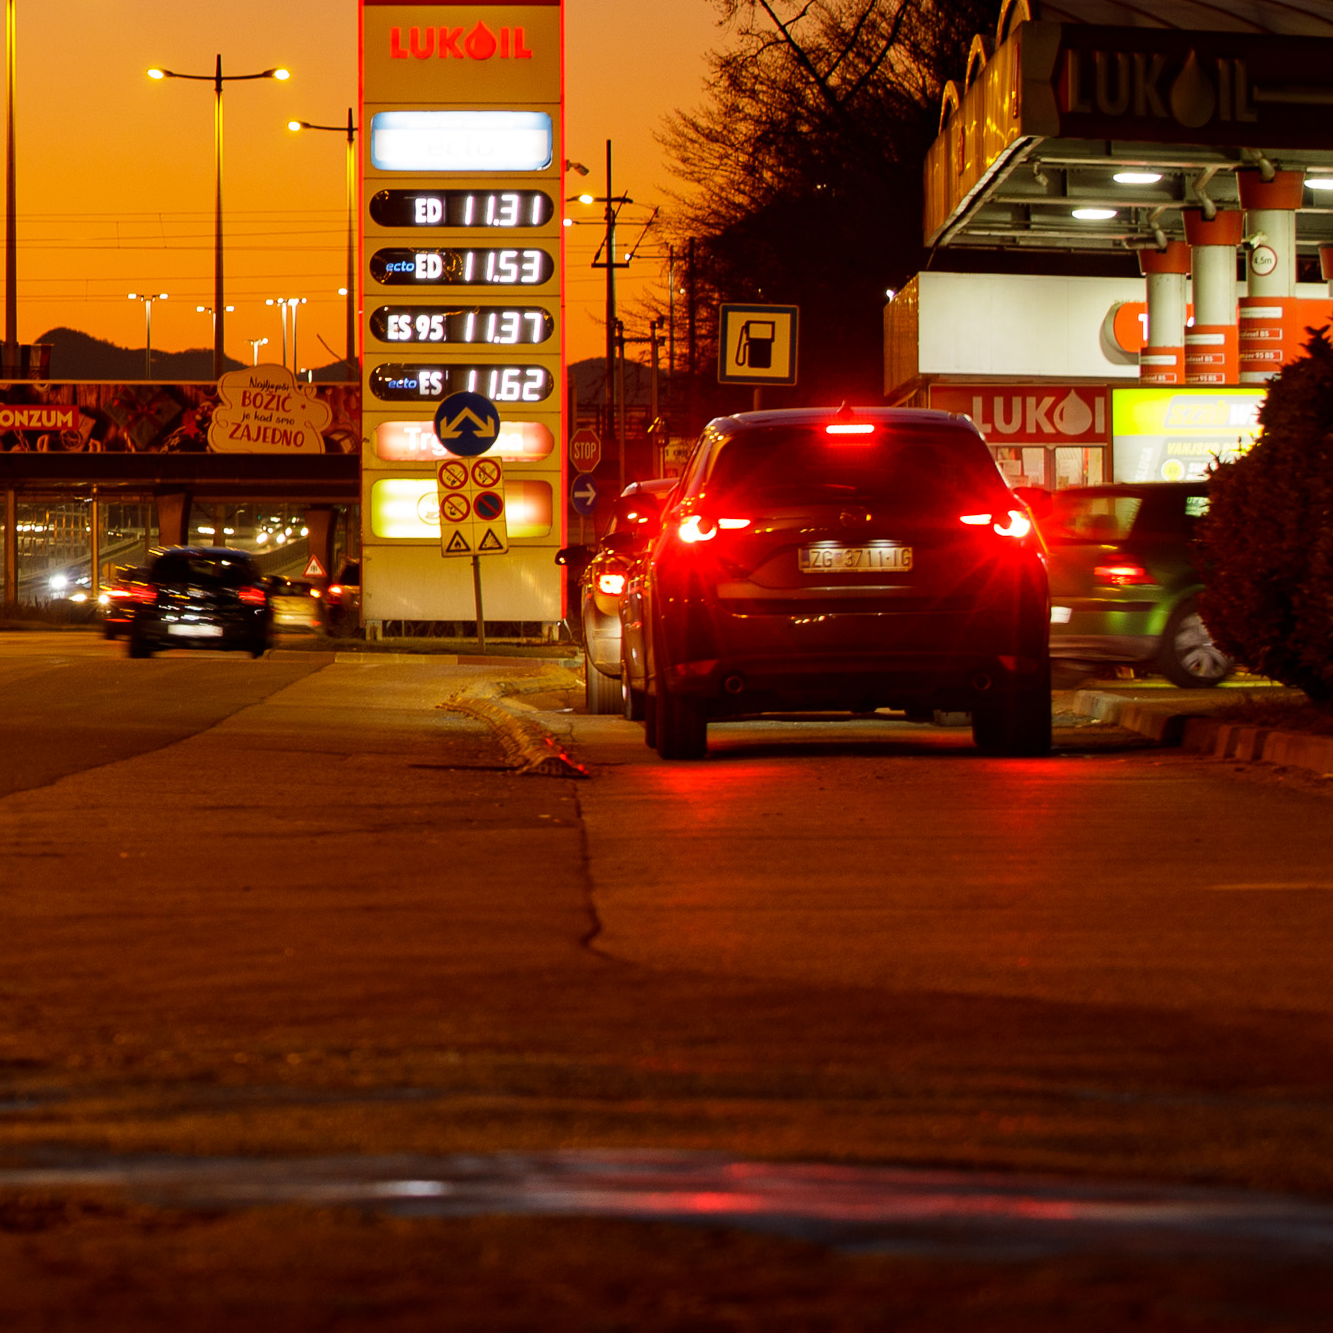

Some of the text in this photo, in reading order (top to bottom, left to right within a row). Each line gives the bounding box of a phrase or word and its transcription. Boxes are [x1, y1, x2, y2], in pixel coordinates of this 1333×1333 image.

[389, 20, 533, 61] LUKOIL
[1068, 45, 1258, 128] LUKOIL
[414, 194, 542, 227] ED 11.31
[385, 250, 542, 283] ecto ED 11.53
[386, 311, 544, 345] ES 95 11.37
[240, 389, 293, 414] BOŽIĆ
[387, 368, 546, 402] ecto ES 11.62
[240, 411, 251, 424] je
[254, 410, 273, 423] kad
[228, 422, 305, 448] ZAJEDNO
[574, 441, 597, 460] STOP
[811, 550, 833, 568] ZG
